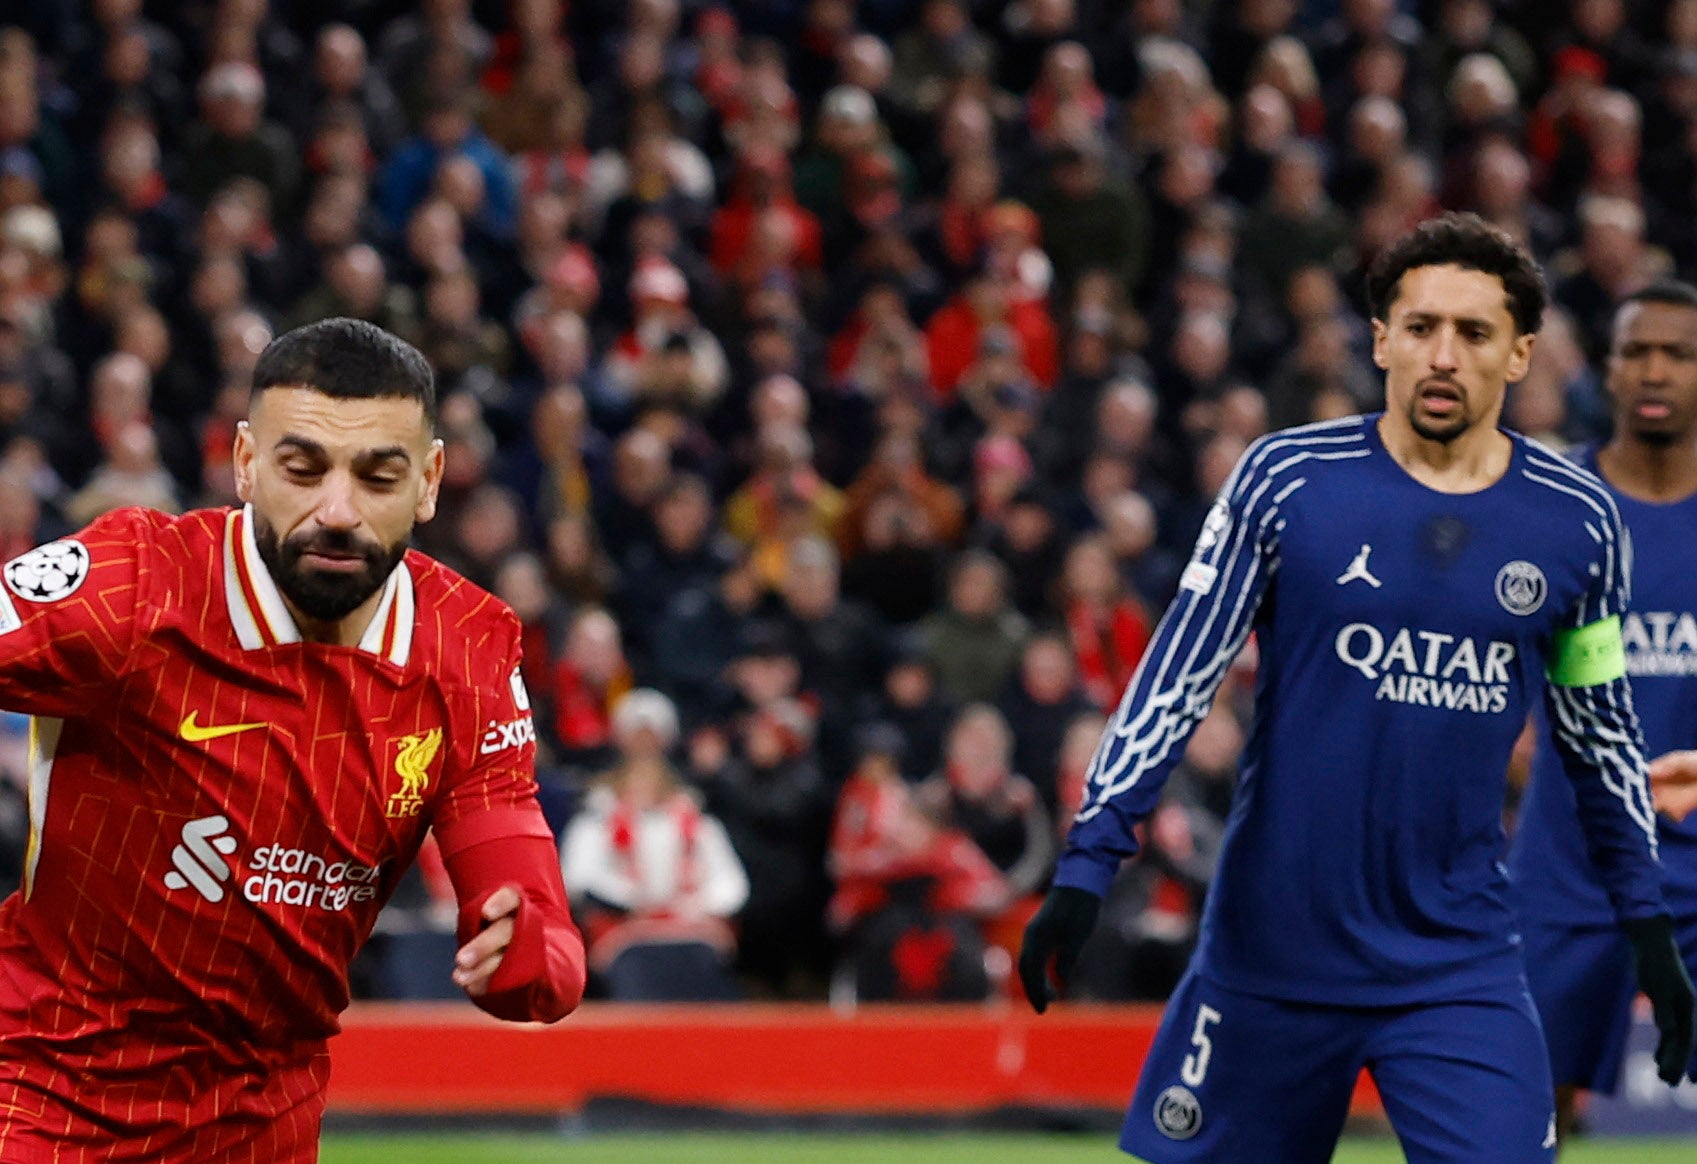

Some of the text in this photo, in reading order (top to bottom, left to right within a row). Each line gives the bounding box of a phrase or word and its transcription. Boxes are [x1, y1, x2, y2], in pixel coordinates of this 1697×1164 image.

[1622, 611, 1697, 651] ATA
[1335, 623, 1515, 683] QATAR
[1375, 673, 1509, 713] AIRWAYS
[481, 716, 536, 761] Expe
[249, 842, 381, 884] standar
[244, 872, 376, 911] chartere
[1181, 1003, 1222, 1087] 5
